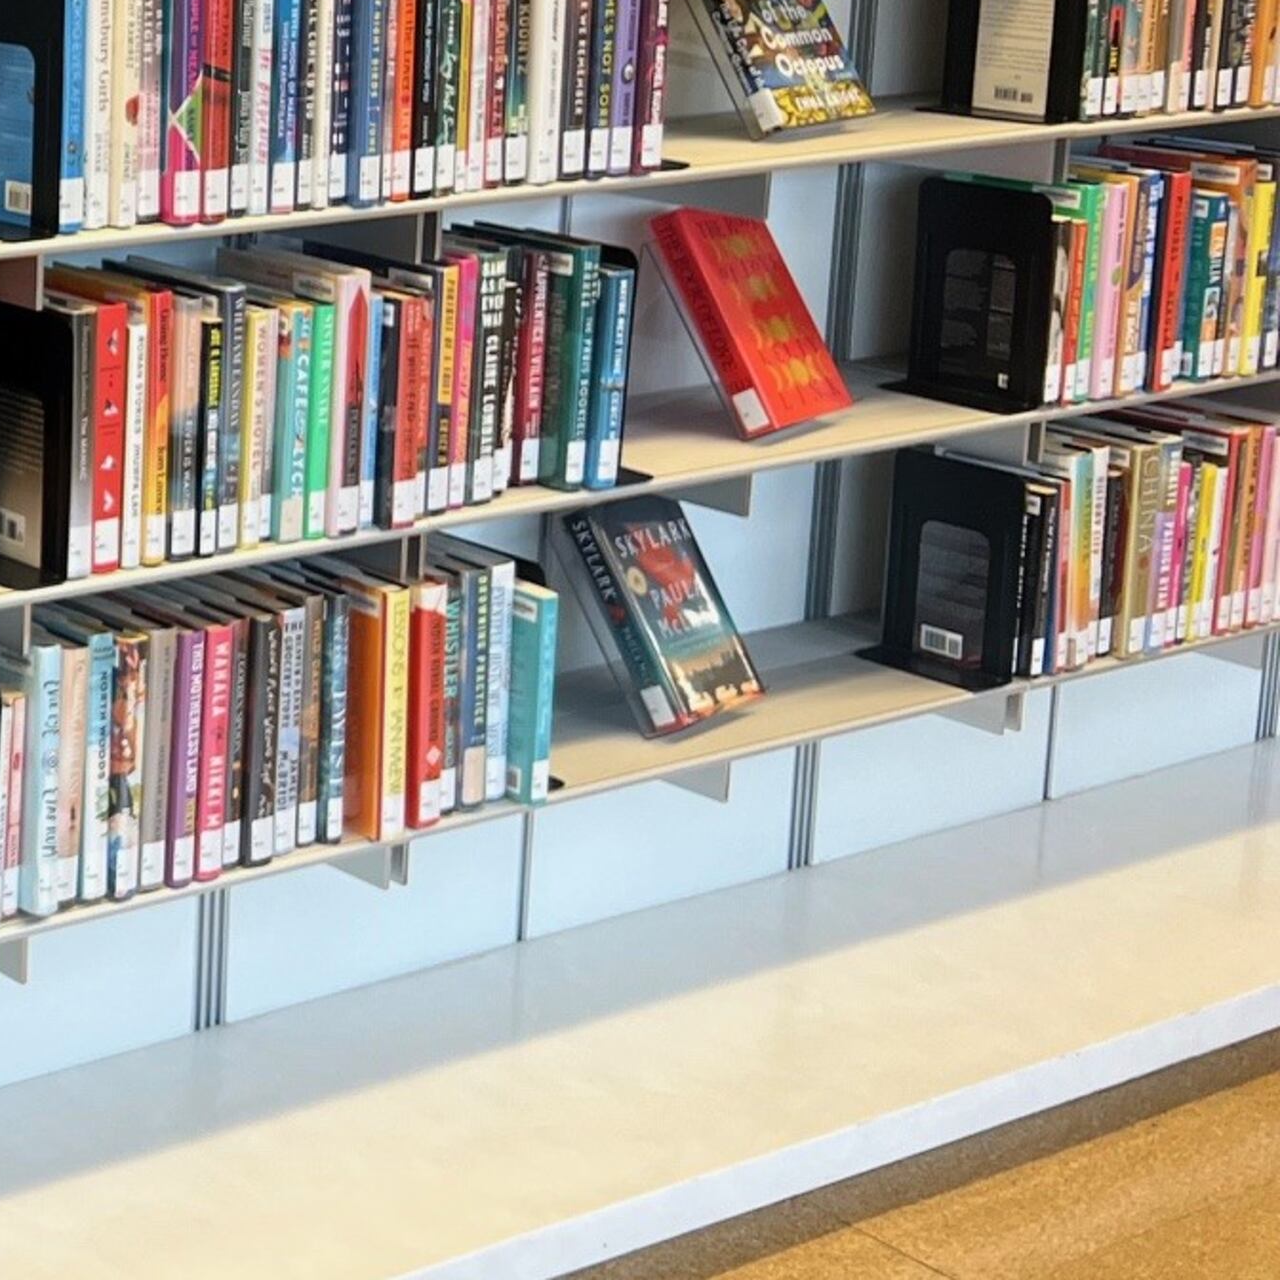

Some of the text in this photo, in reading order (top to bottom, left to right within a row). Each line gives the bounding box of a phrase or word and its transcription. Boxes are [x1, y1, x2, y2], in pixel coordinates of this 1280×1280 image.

[761, 2, 809, 22] of the
[759, 27, 833, 50] Common
[774, 53, 844, 85] Octopus
[613, 518, 691, 559] SKYLARK
[571, 519, 617, 603] SKYLARK
